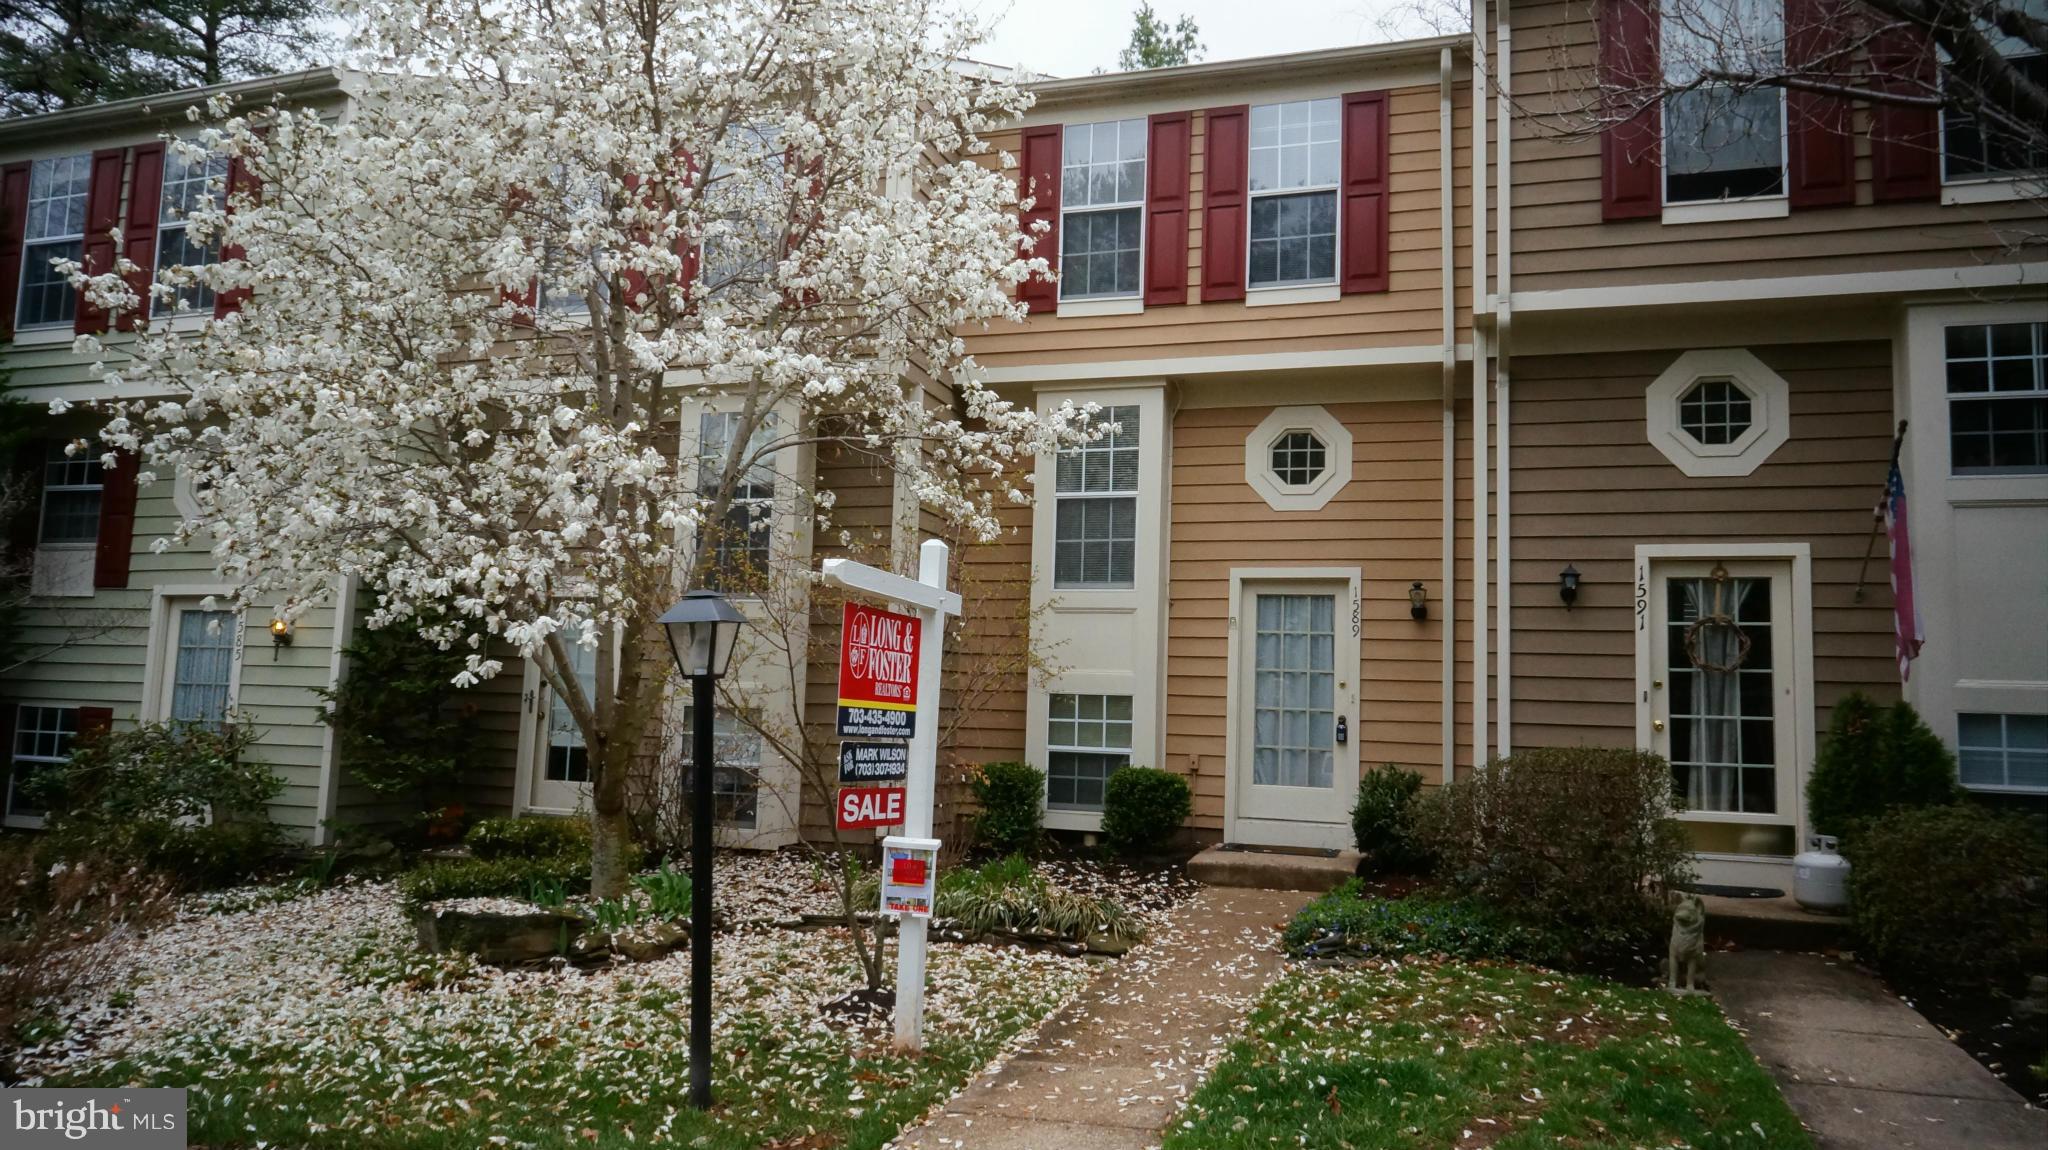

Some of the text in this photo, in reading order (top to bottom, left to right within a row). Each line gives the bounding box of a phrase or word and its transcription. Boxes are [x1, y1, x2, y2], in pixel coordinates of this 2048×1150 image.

[1352, 586, 1360, 638] 1589
[1636, 565, 1647, 630] 1591
[870, 615, 914, 653] LONG &
[867, 647, 912, 684] FOSTER
[843, 724, 911, 736] www.longandfoster.com
[855, 748, 906, 761] MARK WILSON
[843, 793, 901, 823] SALE
